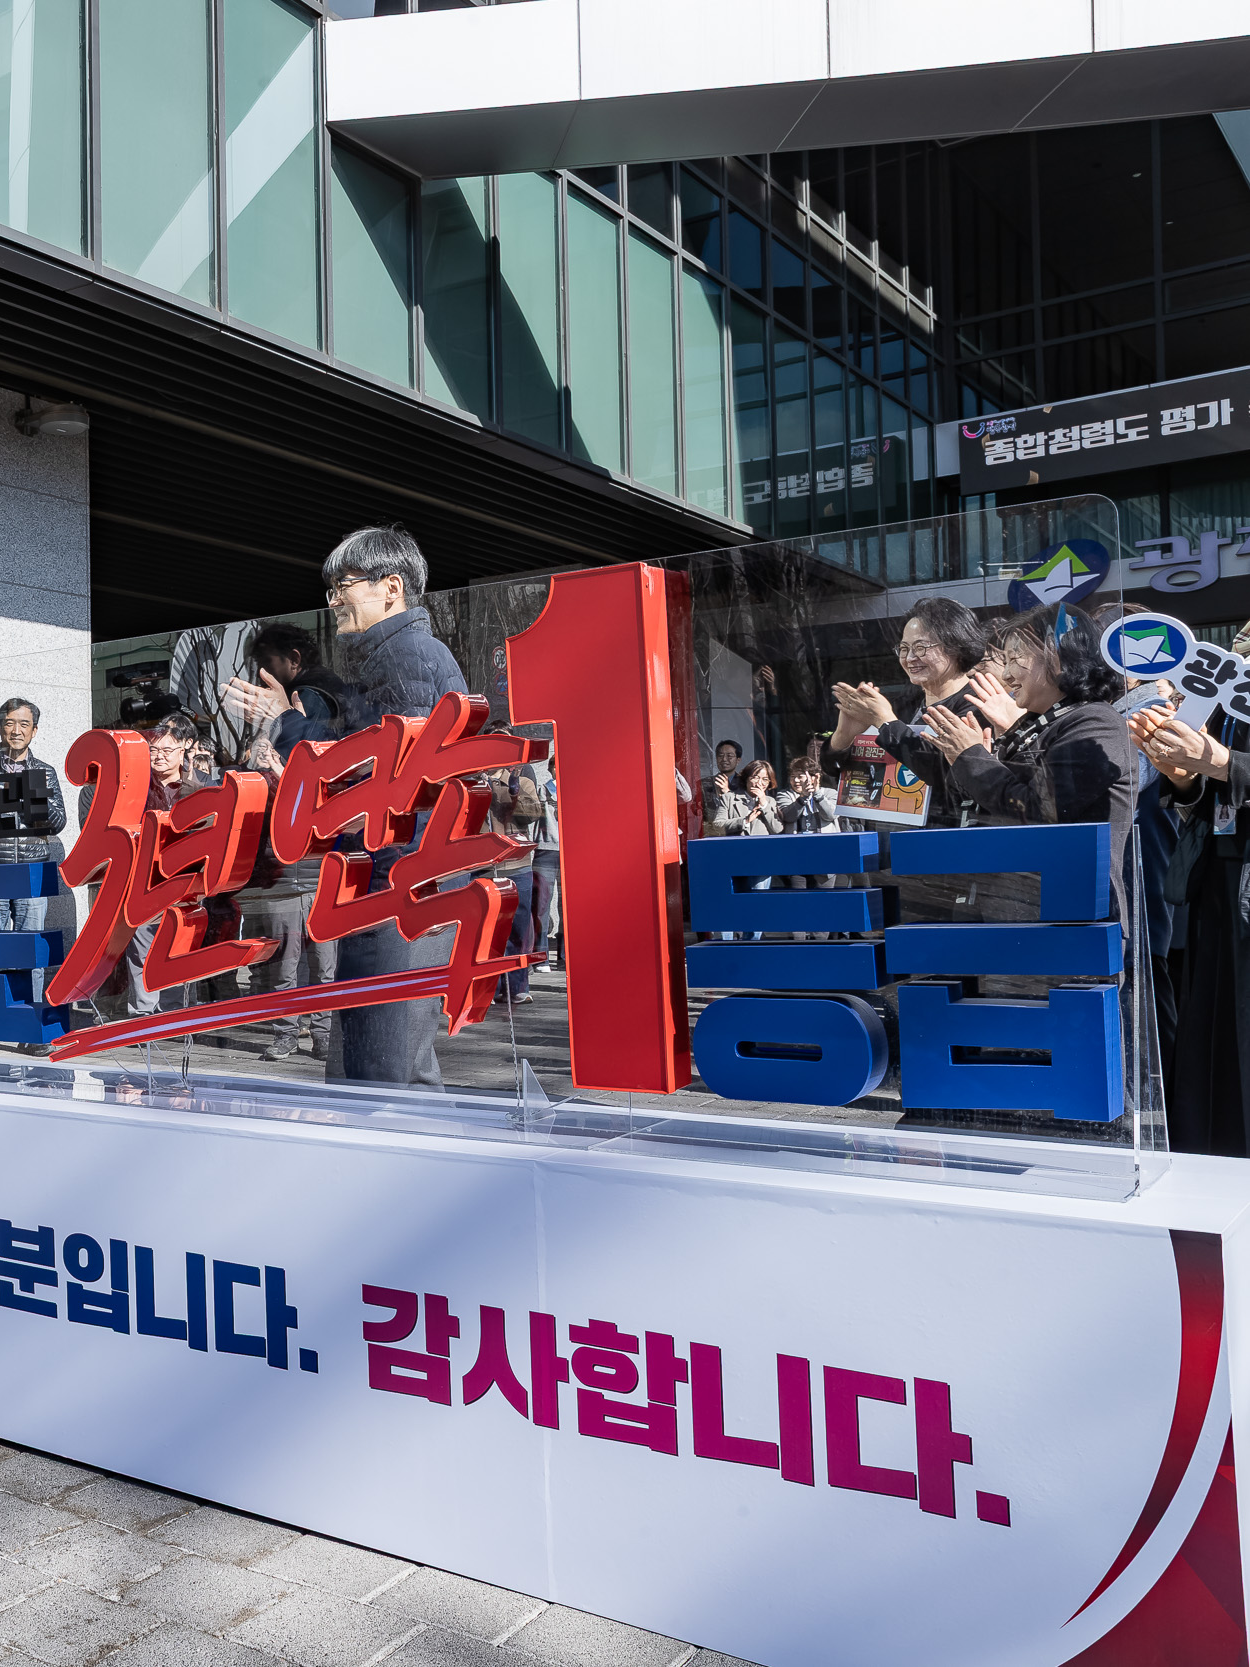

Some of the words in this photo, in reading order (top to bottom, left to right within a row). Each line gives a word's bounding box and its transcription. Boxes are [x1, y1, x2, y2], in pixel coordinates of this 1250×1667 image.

[984, 413, 1150, 466] 종합청렴도
[1160, 398, 1234, 436] 평가
[1129, 525, 1250, 593] 광
[361, 1283, 1011, 1527] 감사합니다.
